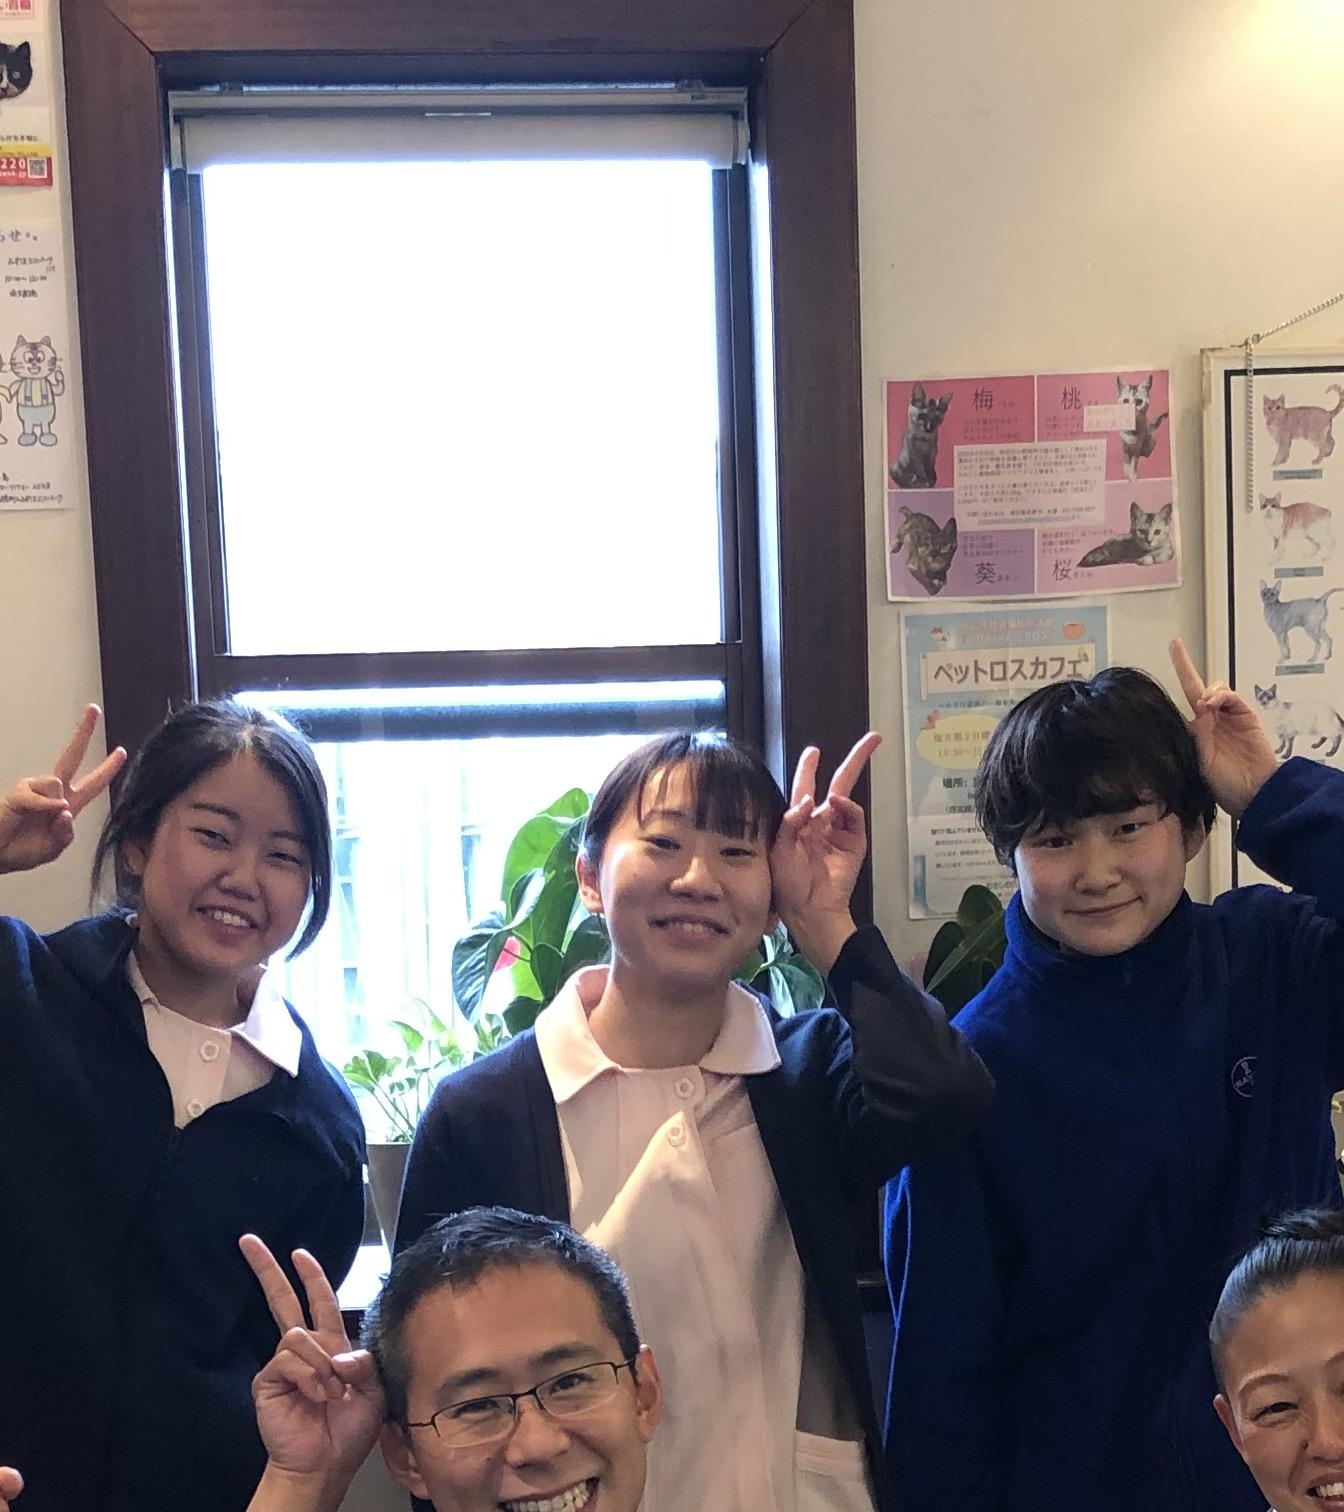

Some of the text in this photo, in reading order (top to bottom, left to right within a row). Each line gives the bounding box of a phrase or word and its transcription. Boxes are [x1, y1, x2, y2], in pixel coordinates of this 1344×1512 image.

[973, 387, 994, 411] 梅
[1061, 386, 1081, 410] 桃
[975, 562, 997, 584] 葵
[1053, 558, 1072, 581] 桜
[933, 655, 1083, 684] ペットロスカフェ
